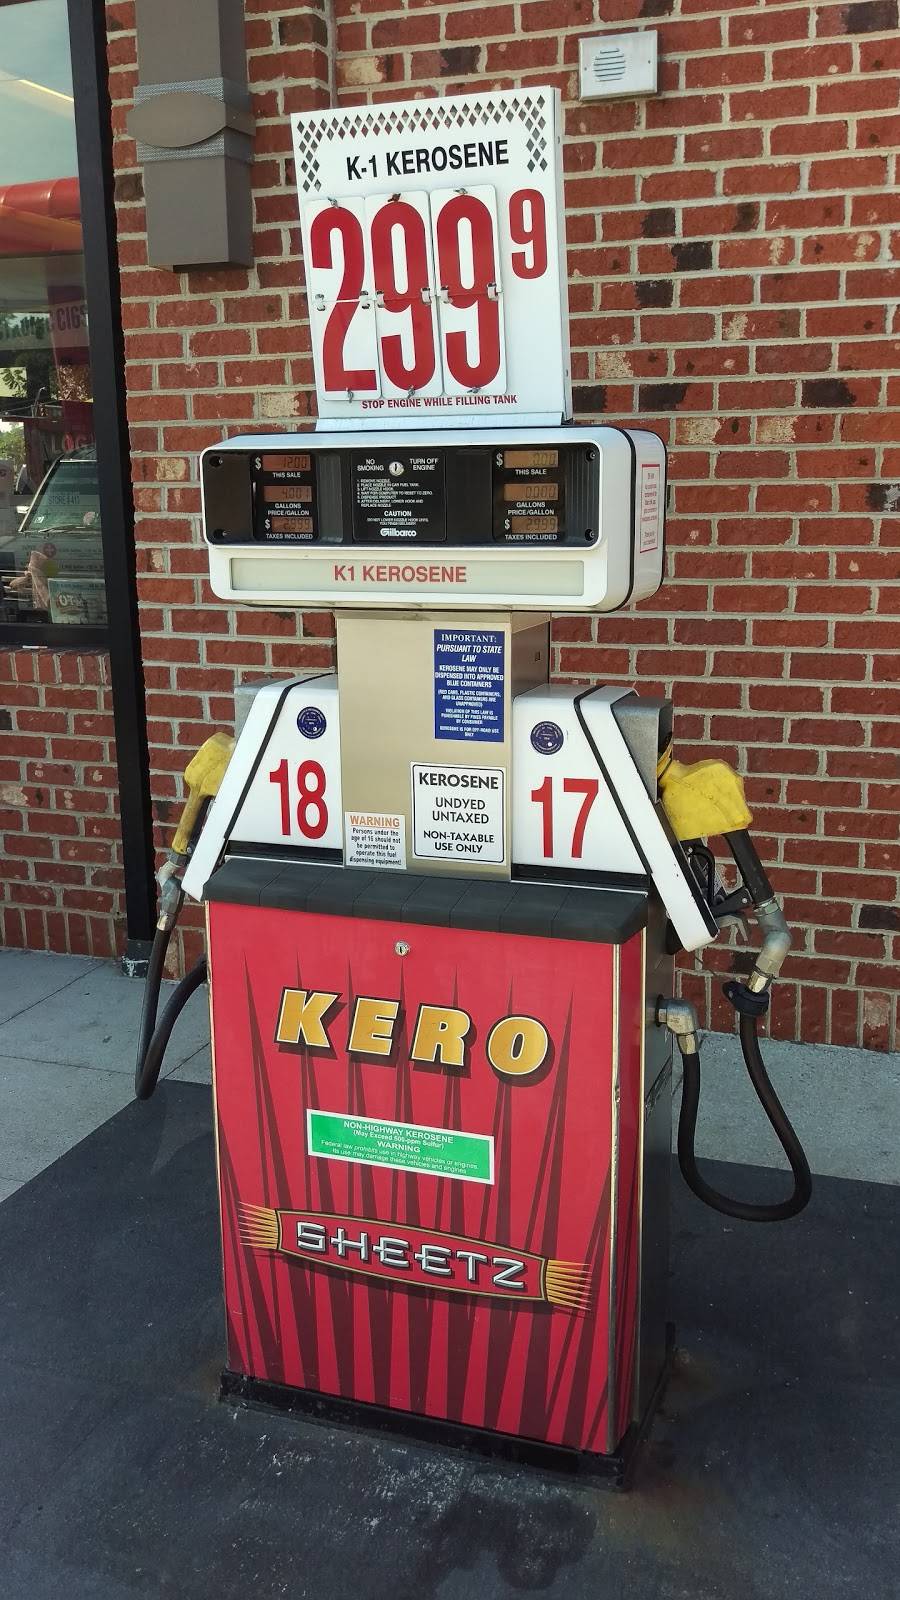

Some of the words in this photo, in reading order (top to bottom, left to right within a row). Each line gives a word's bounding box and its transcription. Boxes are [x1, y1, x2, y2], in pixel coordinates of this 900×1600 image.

[346, 154, 378, 180] K-1
[386, 140, 509, 176] KEROSENE
[310, 194, 501, 391] 299
[509, 188, 547, 279] 9
[362, 400, 385, 409] STOP
[387, 398, 422, 408] ENGINE
[423, 397, 453, 407] WHILE
[455, 396, 492, 406] FILLING
[492, 394, 517, 404] TANK
[255, 457, 261, 470] $
[496, 453, 503, 467] $
[265, 519, 270, 529] $
[505, 519, 510, 530] $
[380, 528, 416, 536] Gilbarco
[334, 566, 355, 581] K1
[363, 566, 467, 582] KEROSENE
[442, 634, 496, 643] IMPORTANT:
[437, 644, 470, 652] PURSUANT
[419, 772, 498, 789] KEROSENE
[270, 759, 328, 839] 18
[436, 797, 485, 810] UNDYED
[350, 816, 399, 827] WARNING
[433, 811, 489, 824] UNTAXED
[531, 777, 598, 858] 17
[424, 830, 494, 843] NON-TAXABLE
[435, 842, 453, 851] USE
[456, 843, 482, 853] ONLY
[275, 986, 551, 1080] KERO
[344, 1121, 403, 1135] NON-HIGHWAY
[406, 1130, 453, 1143] KEROSENE
[370, 1132, 392, 1140] Exceed
[377, 1140, 420, 1152] WARNING
[296, 1222, 525, 1289] SHEETZ
